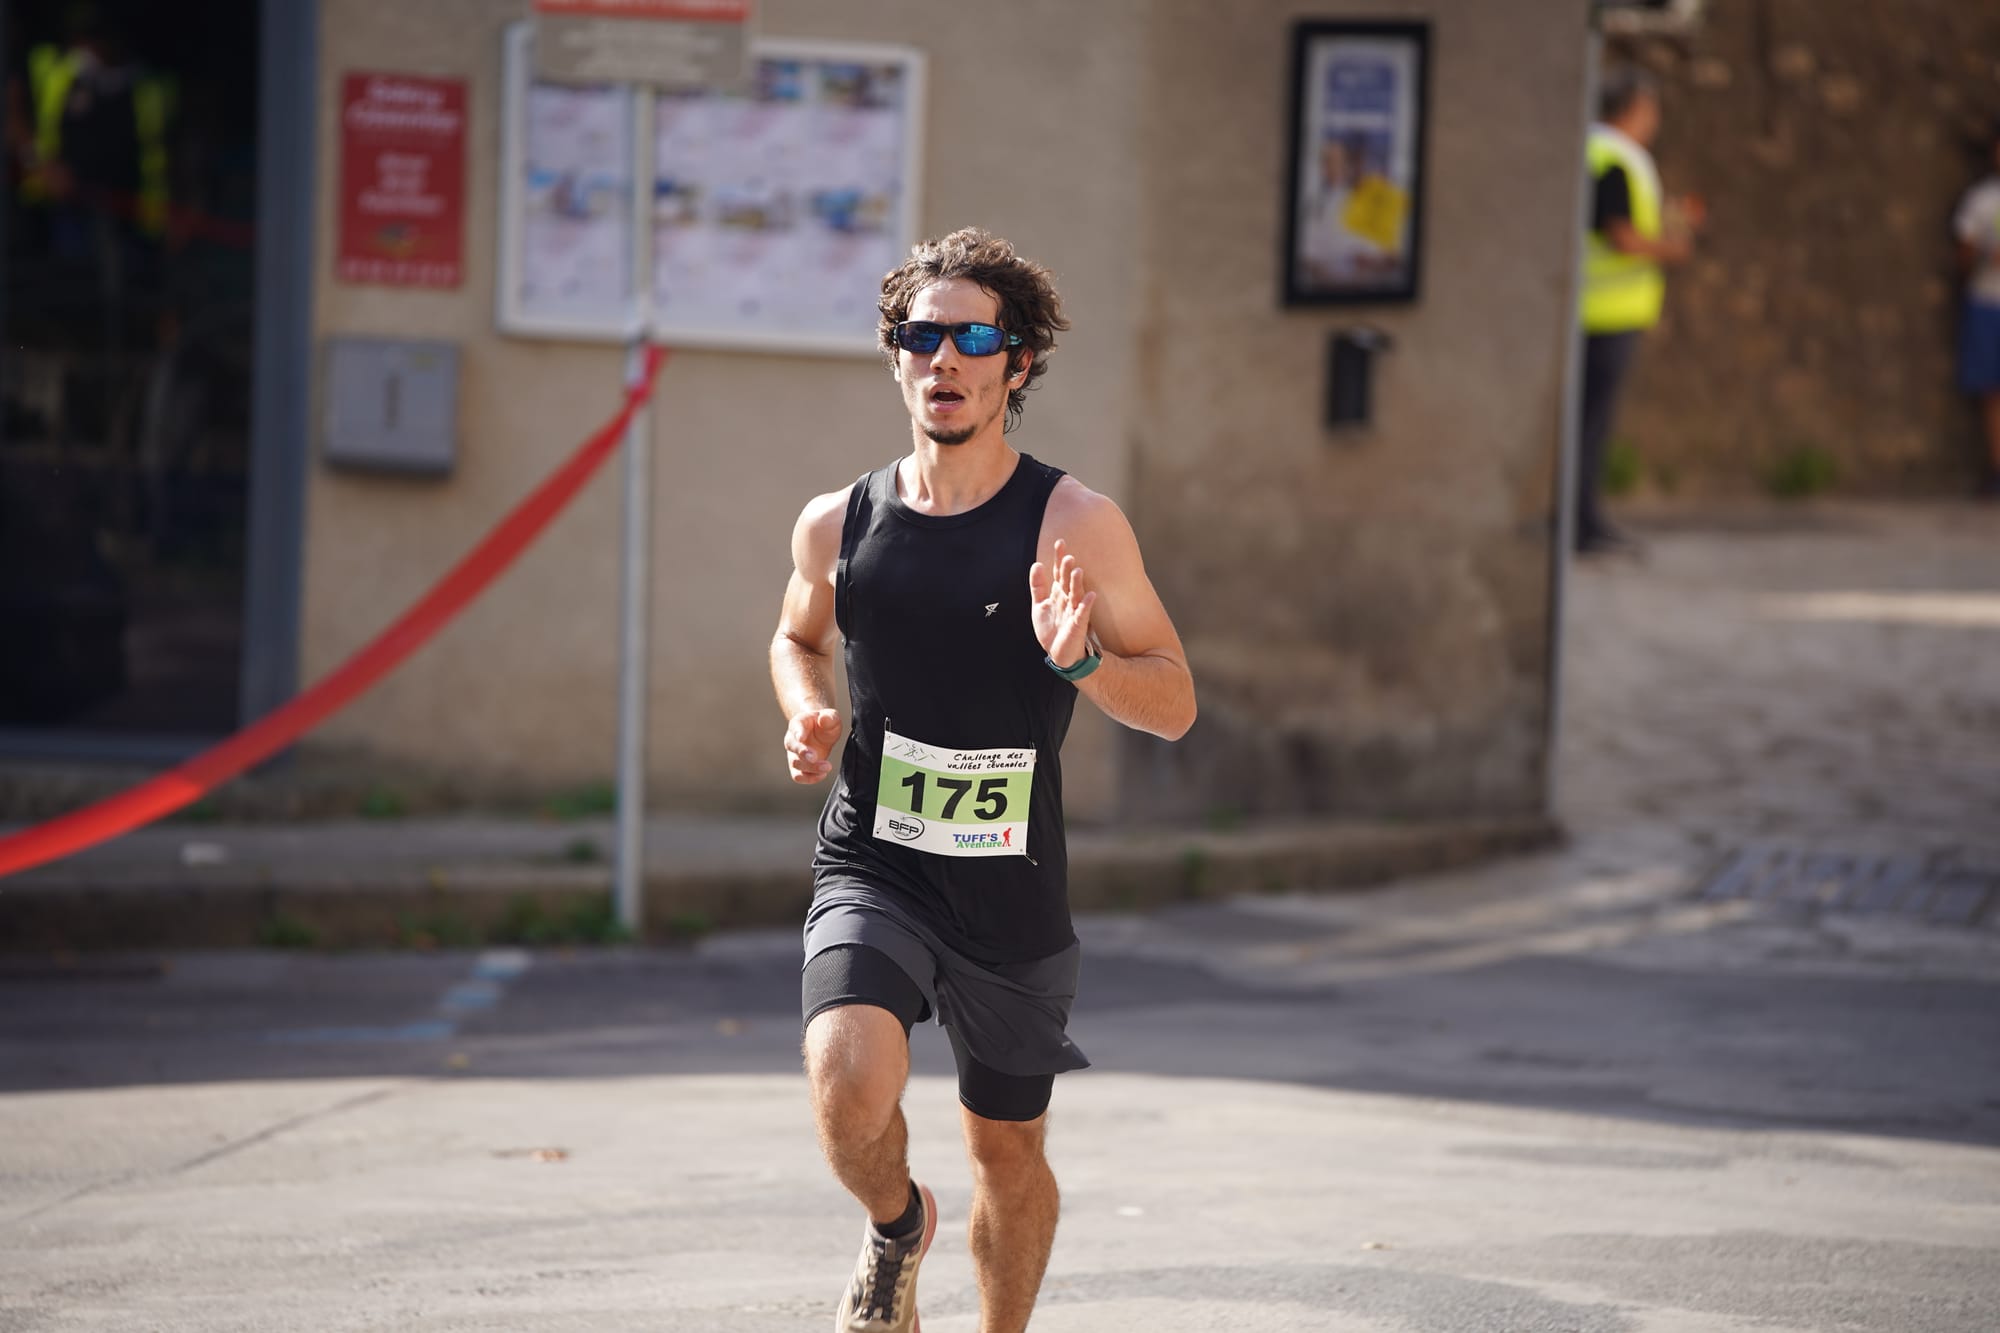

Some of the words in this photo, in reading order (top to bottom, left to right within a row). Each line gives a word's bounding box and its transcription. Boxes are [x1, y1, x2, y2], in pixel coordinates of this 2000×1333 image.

[953, 752, 1002, 762] Challenge
[1007, 751, 1024, 759] des
[947, 761, 982, 770] vallées
[986, 759, 1028, 769] cévenoles
[901, 771, 1008, 821] 175
[889, 819, 919, 834] BFP
[952, 833, 998, 843] TUFF'S
[956, 840, 1003, 848] Aventure
